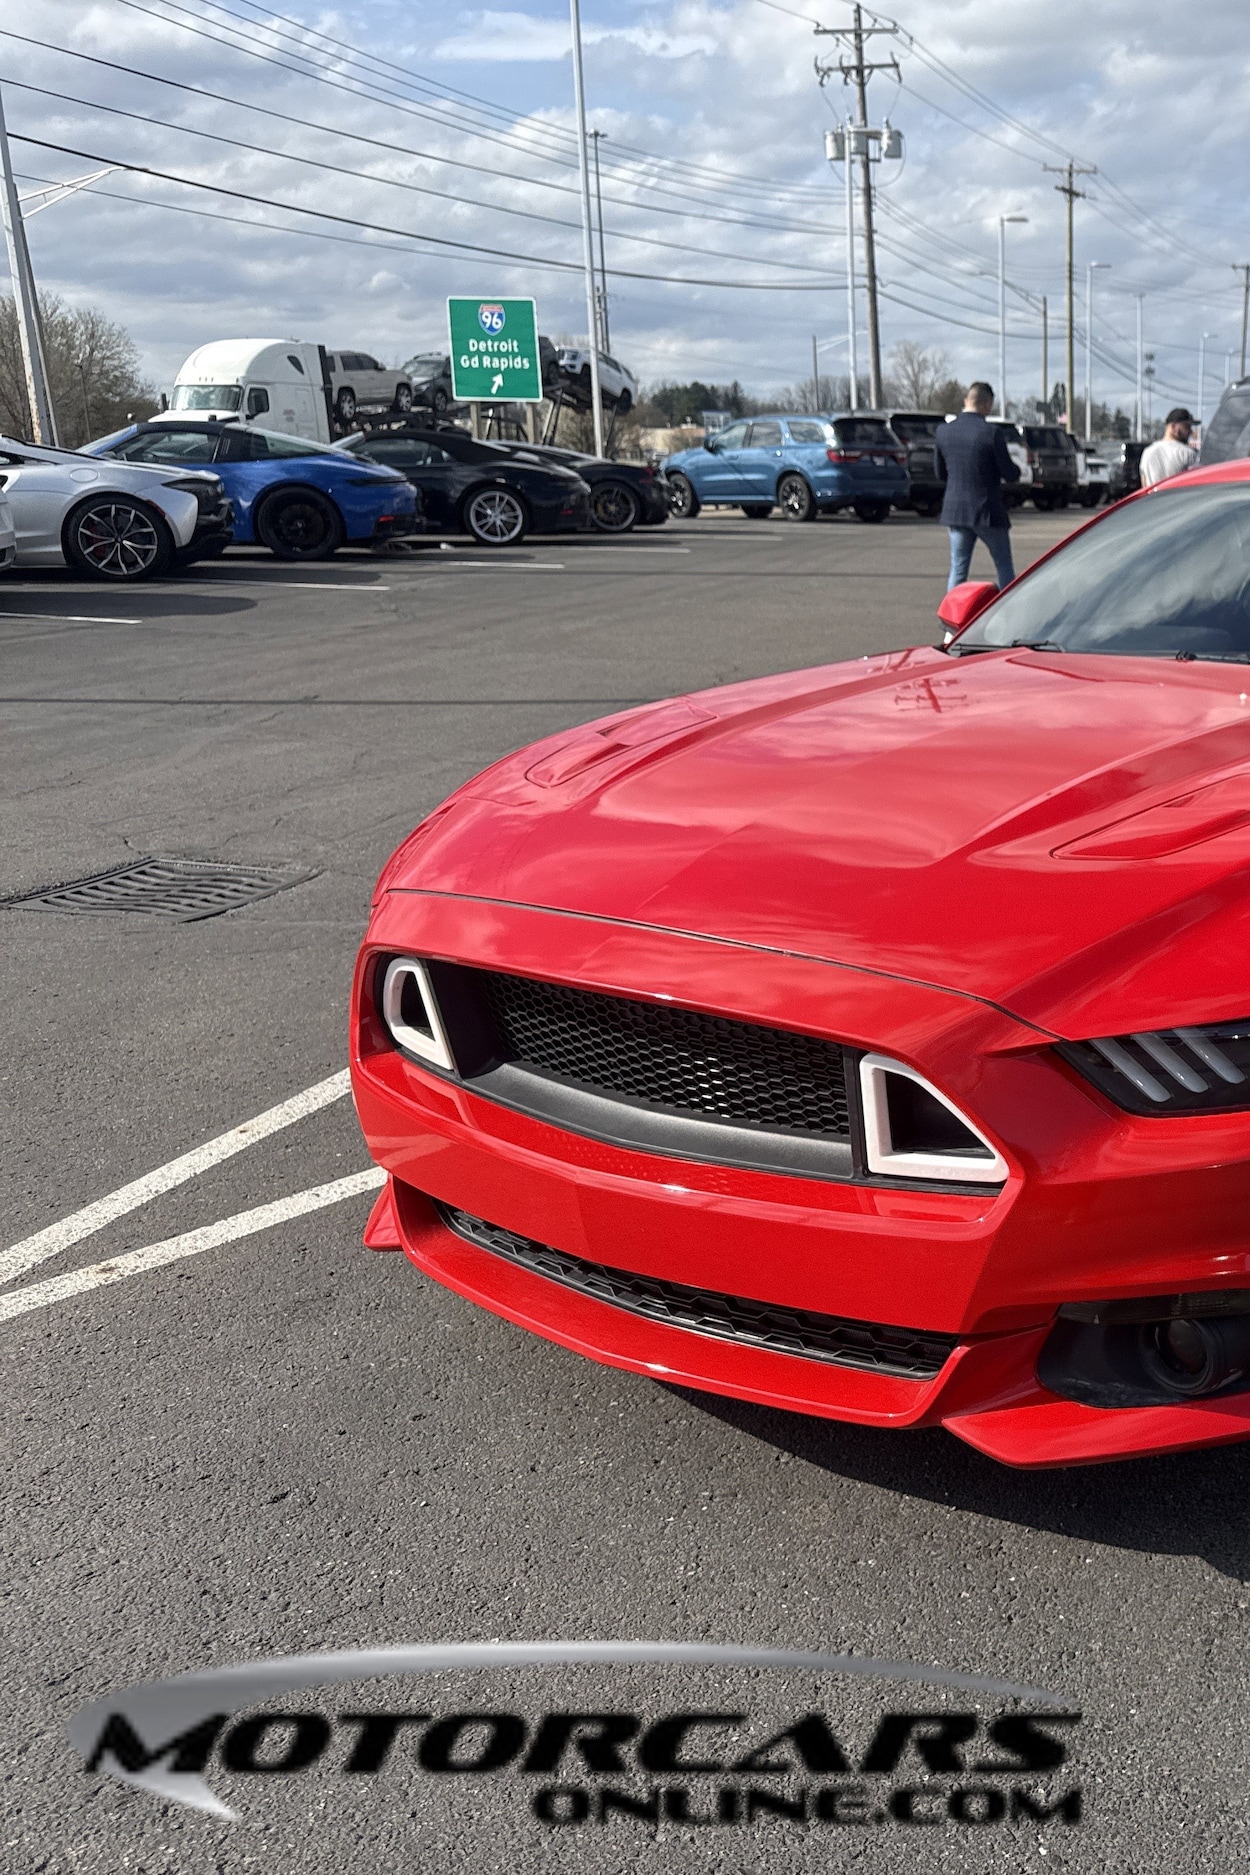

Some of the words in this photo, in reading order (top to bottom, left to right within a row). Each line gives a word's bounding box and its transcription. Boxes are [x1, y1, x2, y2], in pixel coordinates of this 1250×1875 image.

[482, 312, 502, 329] 96
[469, 339, 519, 352] Detroit
[460, 355, 479, 368] Gd
[483, 356, 530, 371] Rapids
